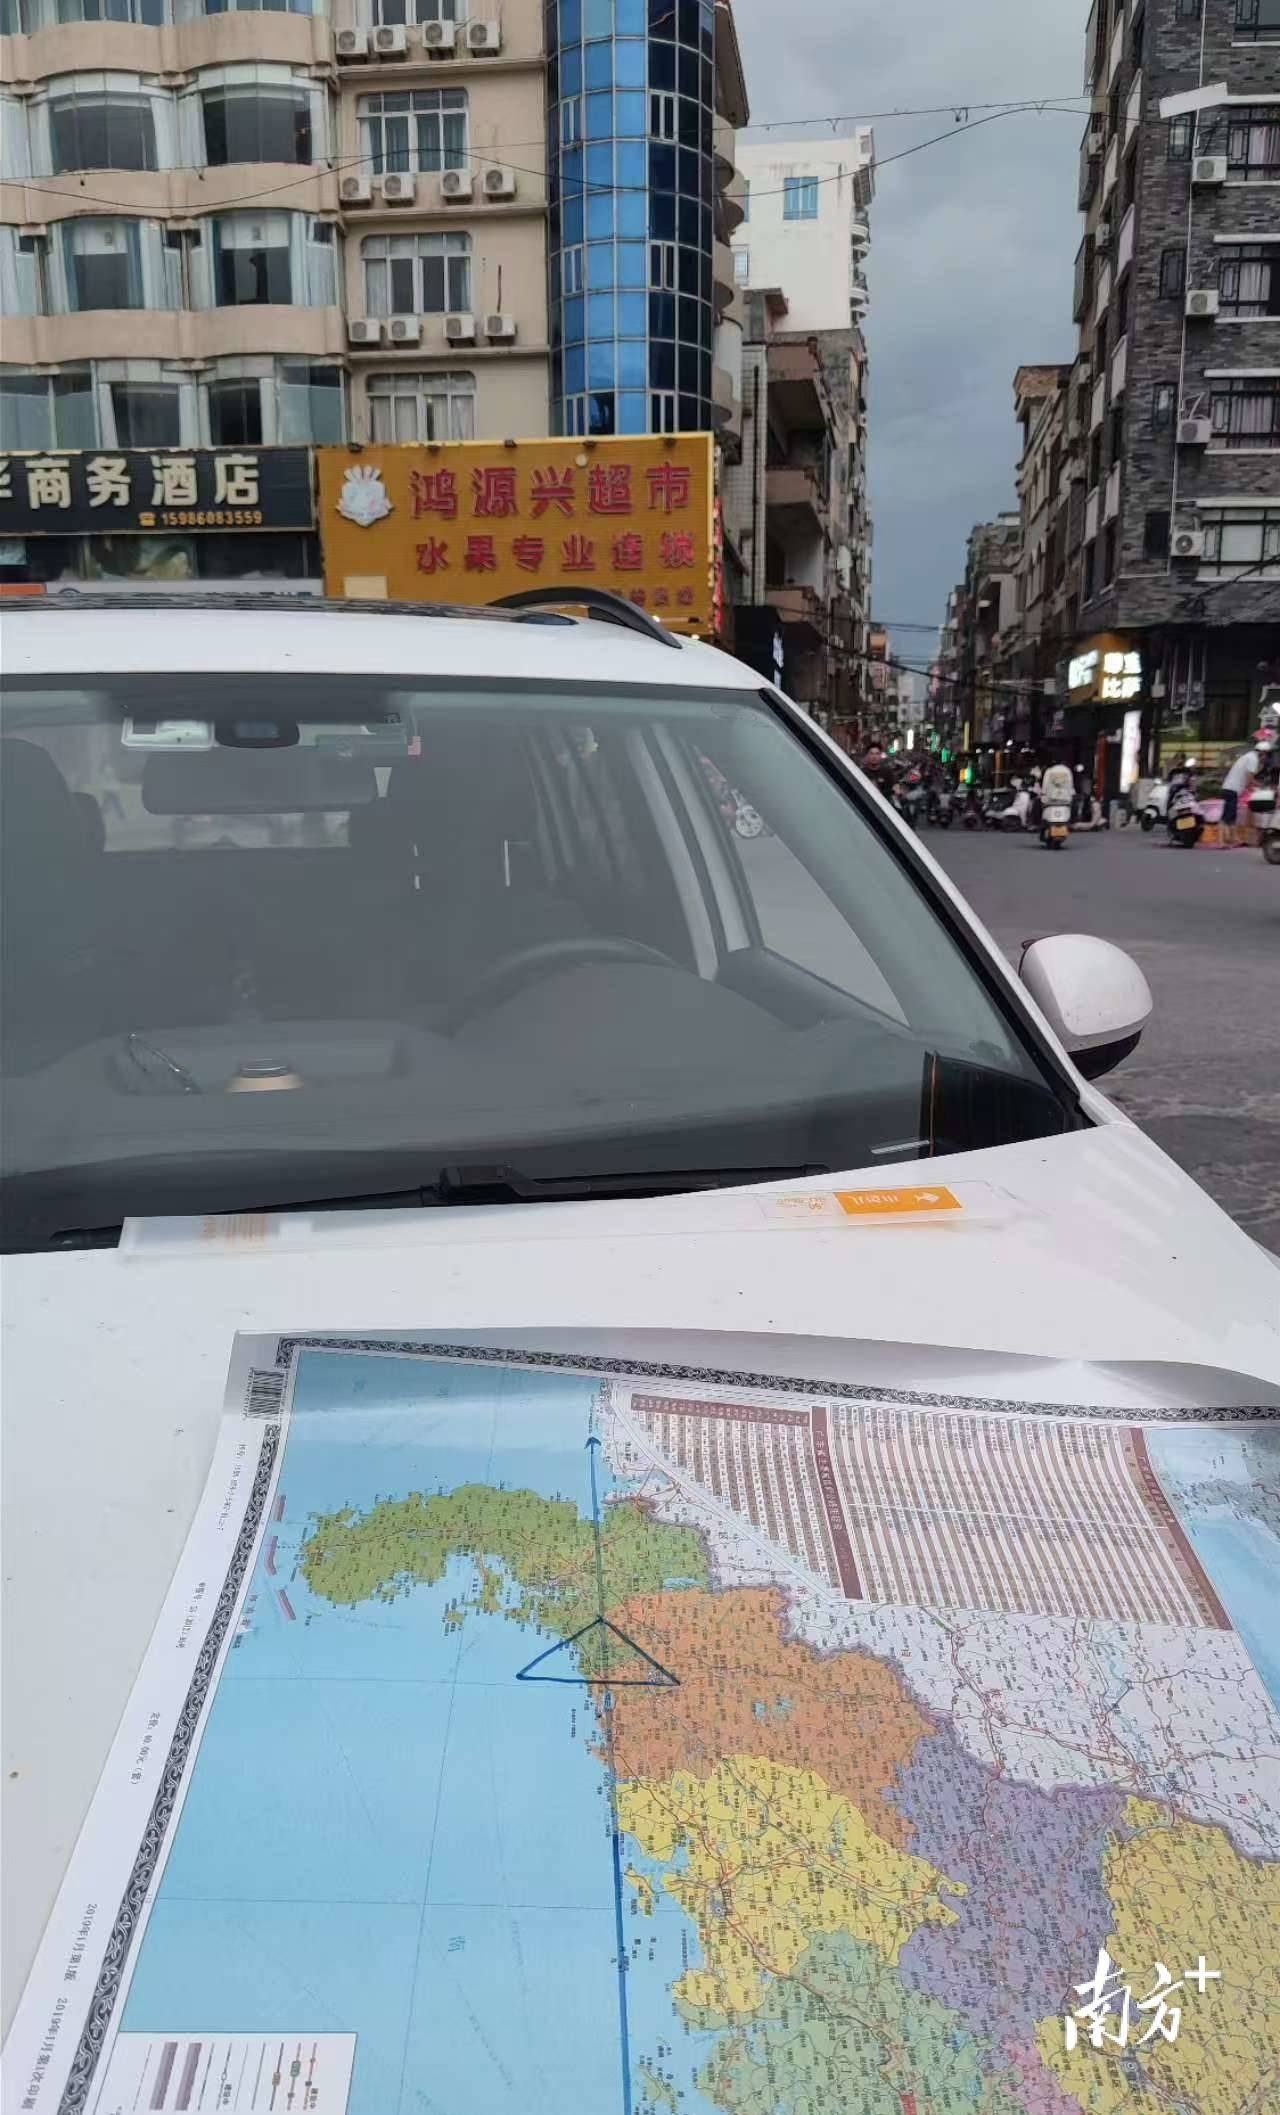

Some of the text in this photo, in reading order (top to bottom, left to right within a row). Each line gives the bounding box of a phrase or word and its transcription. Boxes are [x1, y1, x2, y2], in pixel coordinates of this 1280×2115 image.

[409, 461, 691, 519] 鸿源兴超市
[416, 530, 695, 573] 水果专业连锁
